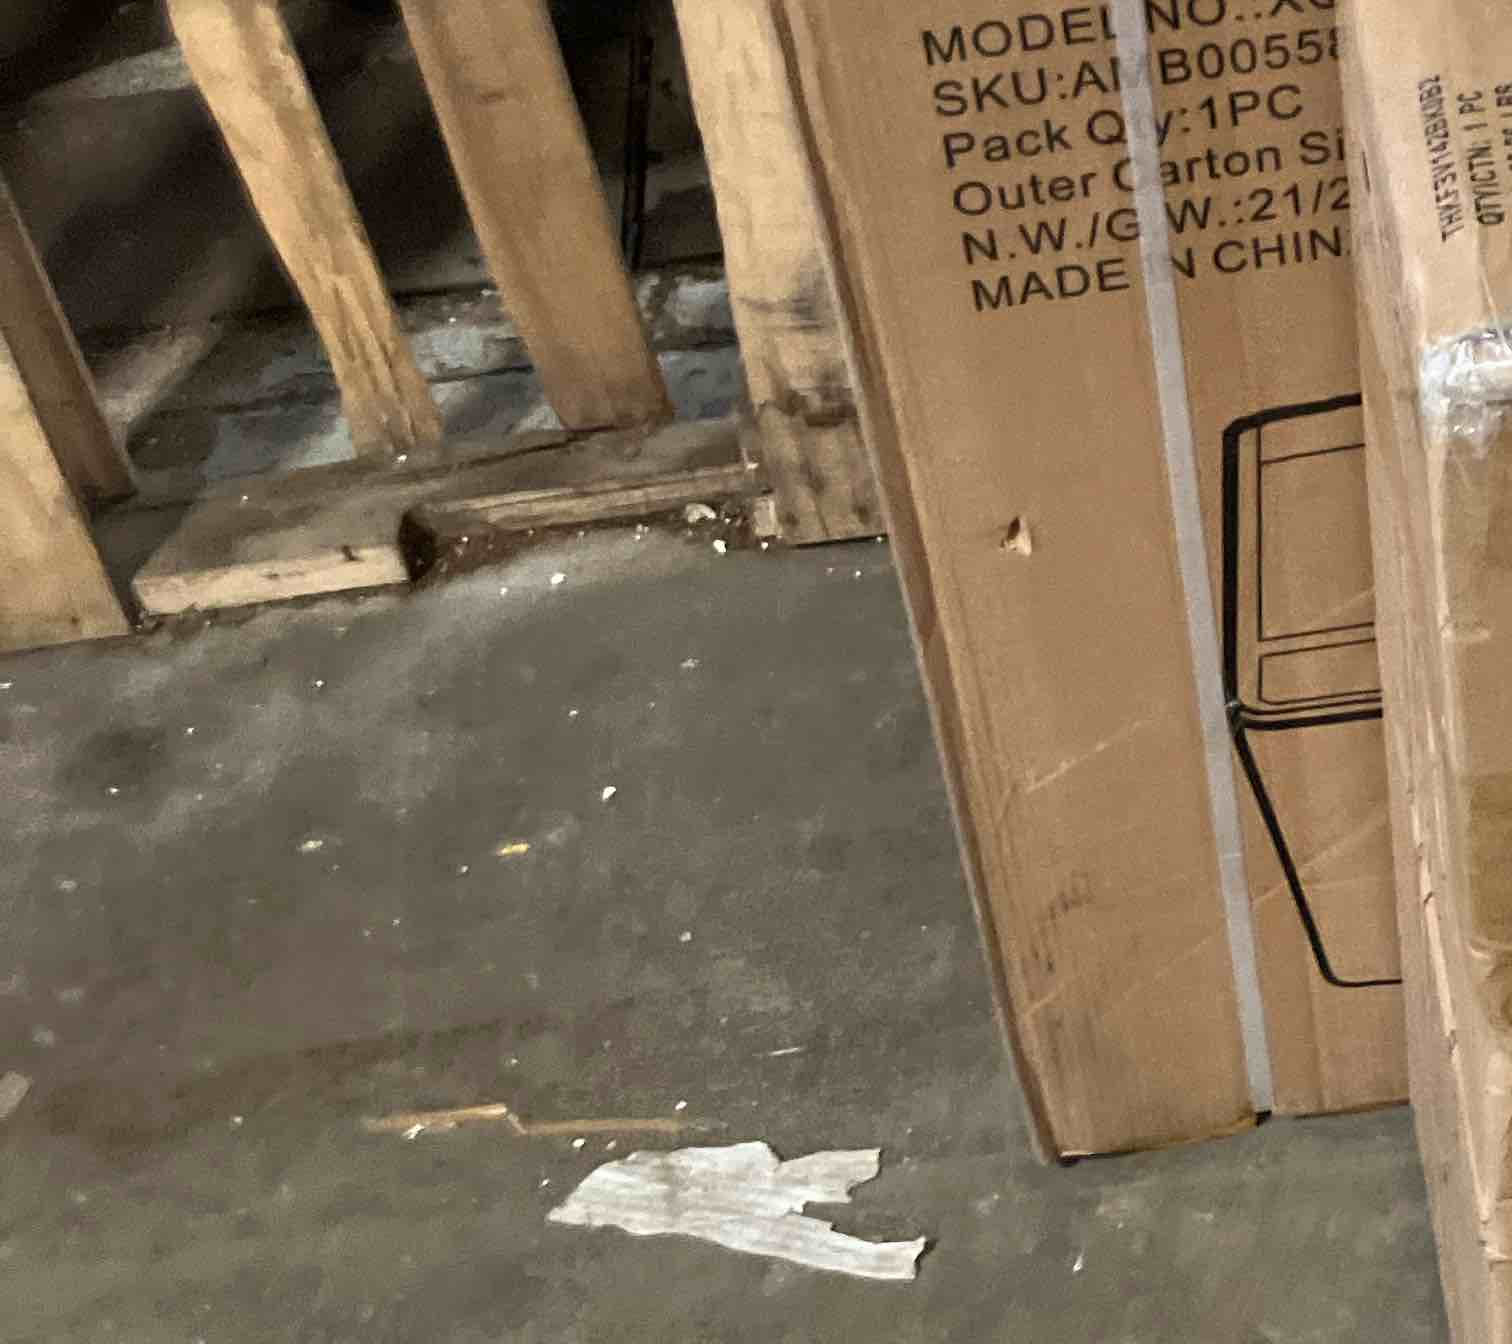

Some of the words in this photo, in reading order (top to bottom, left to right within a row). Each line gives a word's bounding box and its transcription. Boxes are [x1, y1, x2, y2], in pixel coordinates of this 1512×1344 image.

[922, 5, 1118, 67] MODEL
[942, 119, 1073, 169] Pack
[1086, 83, 1303, 148] Qy:1PC
[952, 169, 1098, 218] Outer
[1112, 144, 1283, 195] Carton
[971, 258, 1131, 313] MADE
[1213, 224, 1352, 274] CHIN
